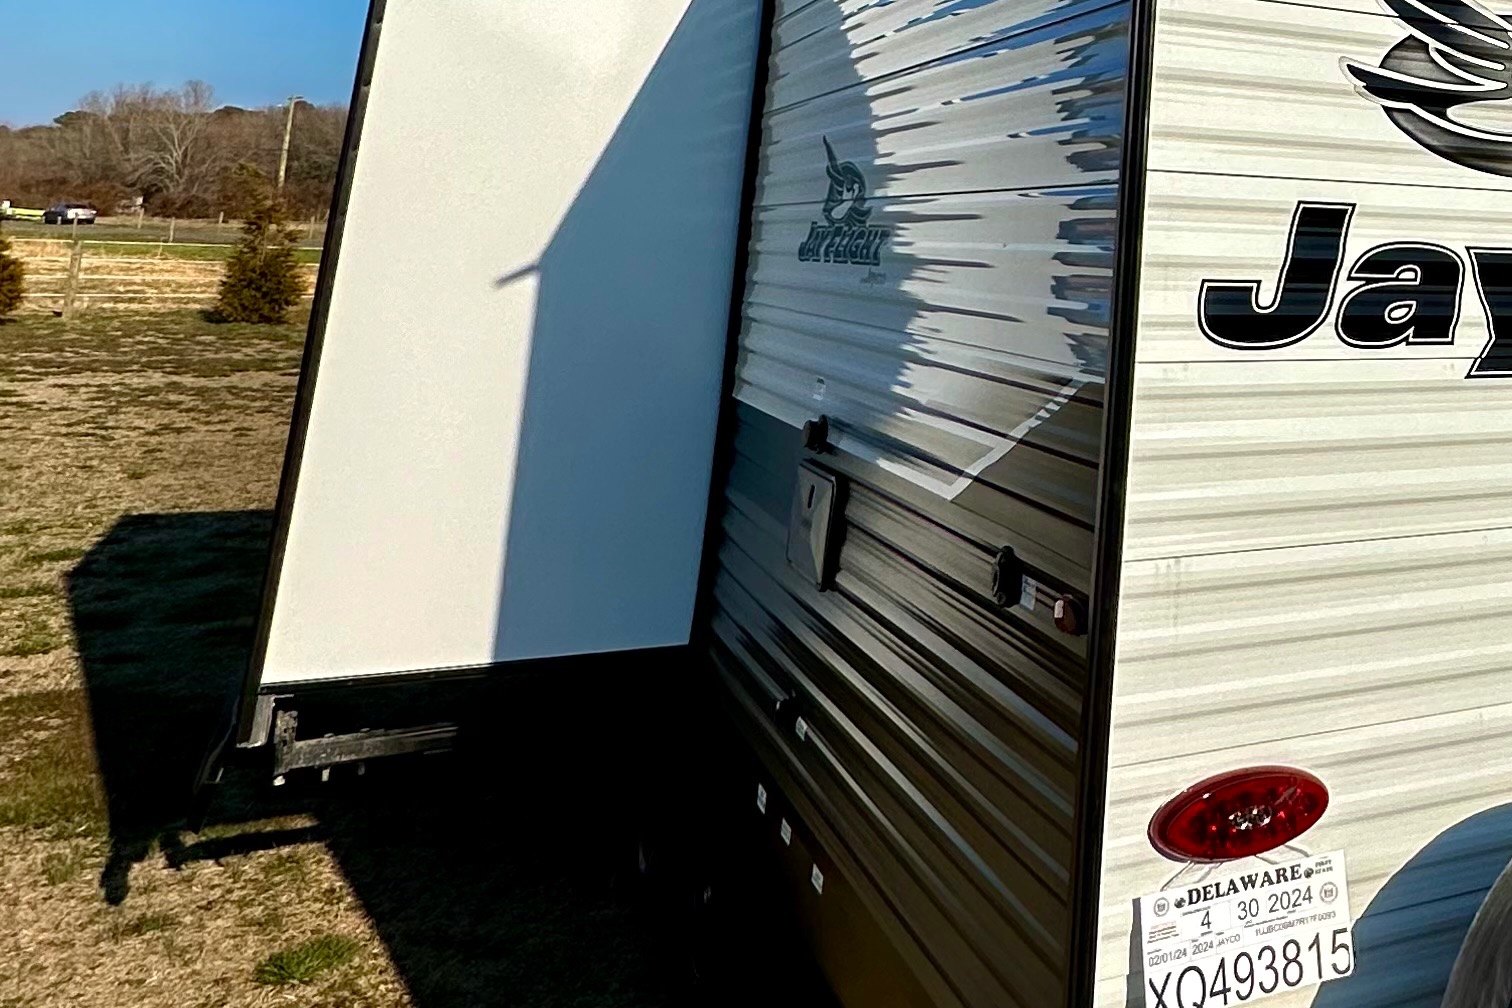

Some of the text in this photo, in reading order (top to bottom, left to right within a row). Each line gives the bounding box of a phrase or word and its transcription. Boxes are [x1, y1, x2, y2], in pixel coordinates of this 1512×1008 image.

[1187, 863, 1302, 906] DELAWARE
[1200, 909, 1211, 930] 4
[1238, 897, 1259, 921] 30
[1268, 885, 1313, 914] 2024
[1148, 947, 1188, 967] 02/01/24
[1192, 941, 1214, 956] 2024
[1215, 934, 1241, 948] JAYCO
[1148, 927, 1351, 1008] XQ493815
